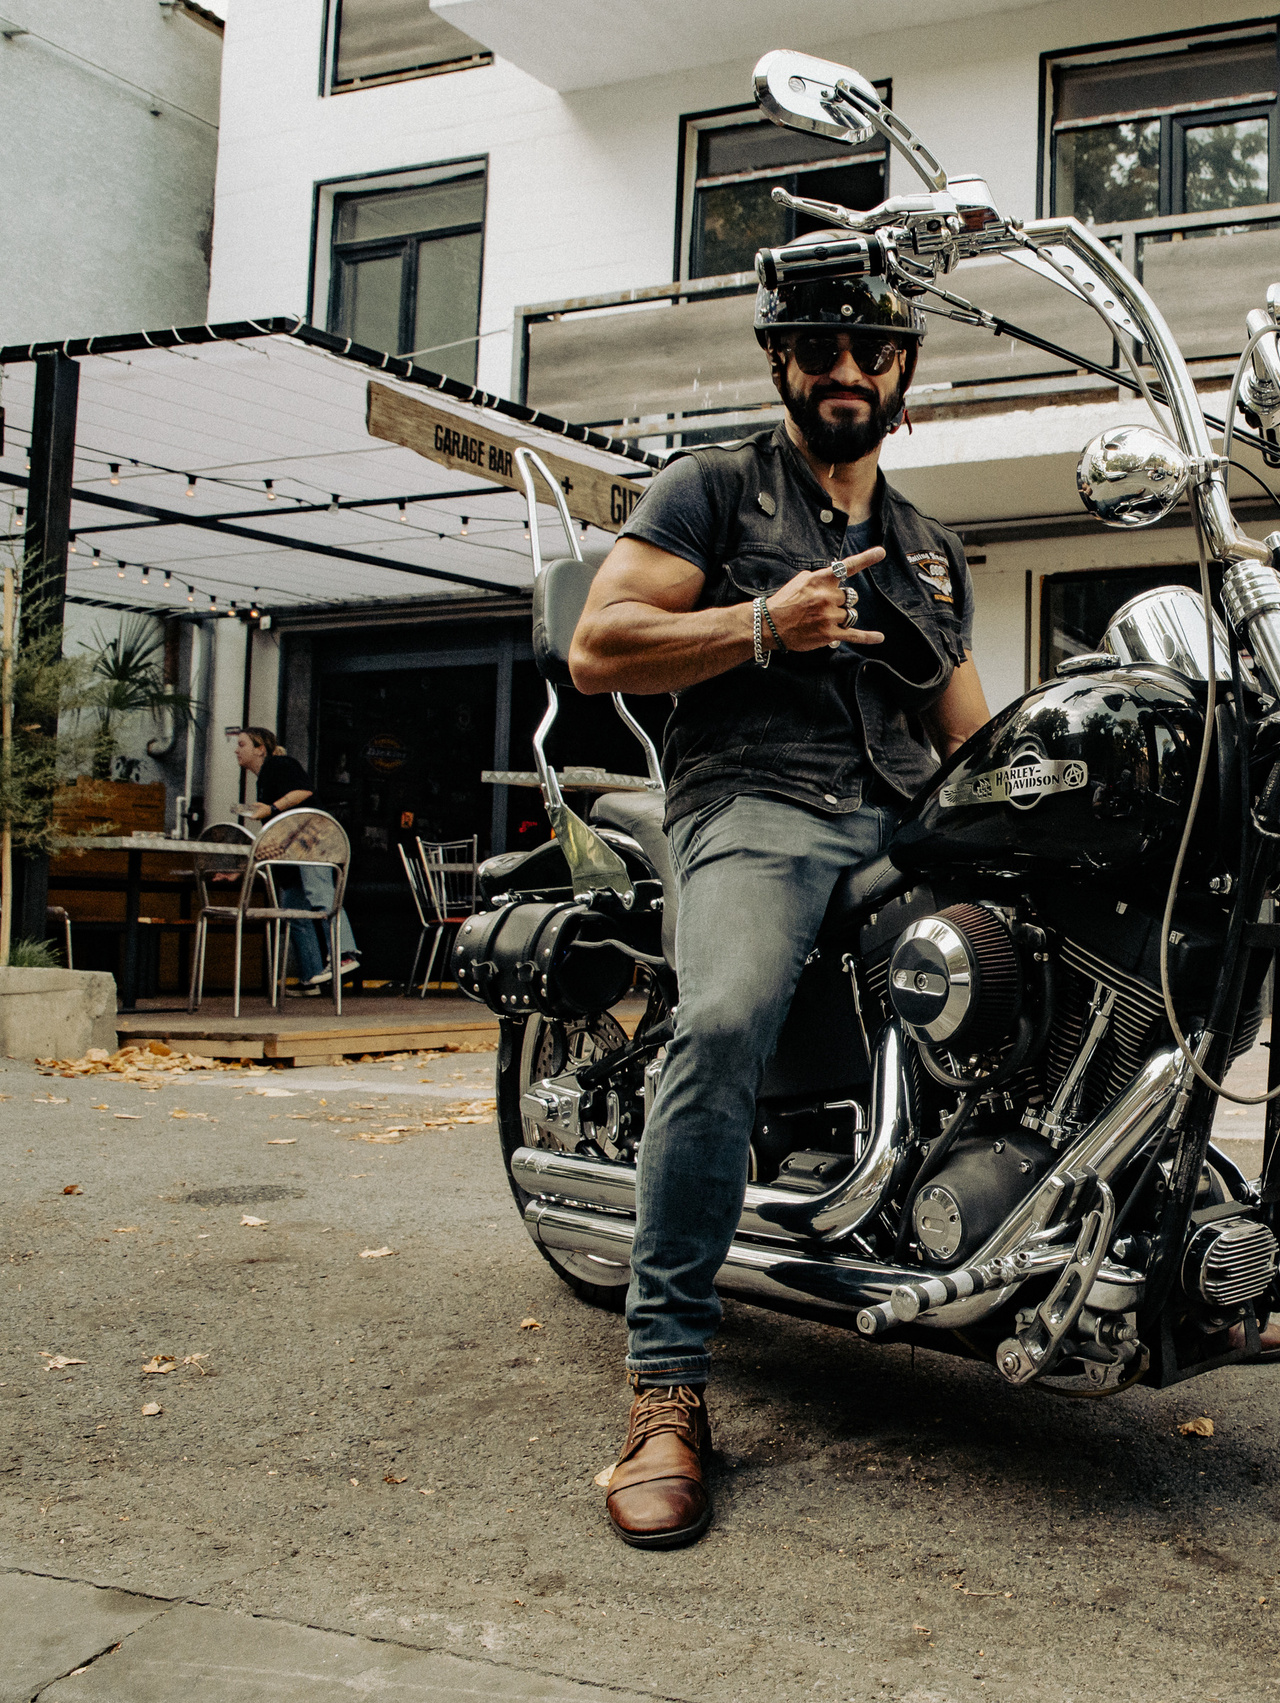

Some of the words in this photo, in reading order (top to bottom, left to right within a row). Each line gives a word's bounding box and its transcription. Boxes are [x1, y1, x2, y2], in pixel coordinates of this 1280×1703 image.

[434, 424, 485, 467] GARAGE
[489, 445, 513, 478] BAR
[996, 766, 1041, 788] HARLEY-
[1005, 773, 1060, 797] DAVIDSON
